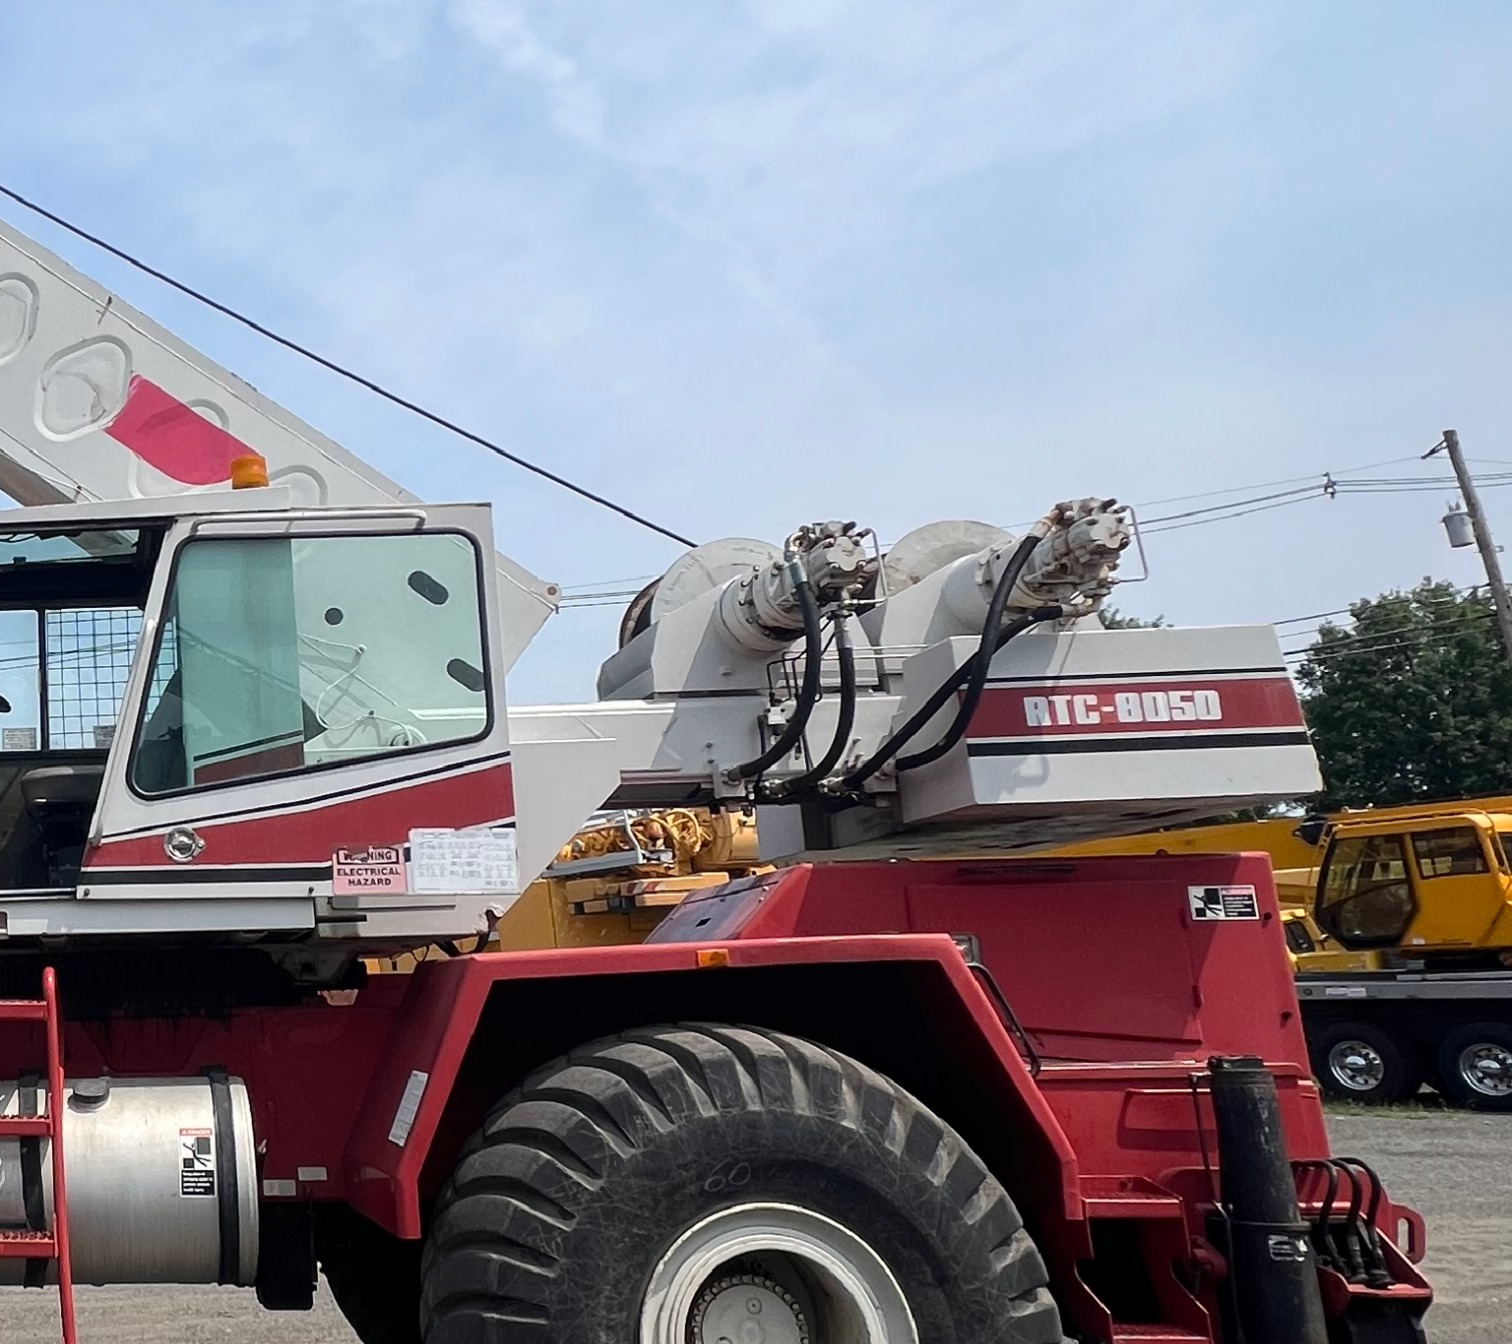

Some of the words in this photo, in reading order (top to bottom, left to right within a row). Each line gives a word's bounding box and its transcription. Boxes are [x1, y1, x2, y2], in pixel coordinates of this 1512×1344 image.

[1023, 690, 1223, 727] RTC-8050
[344, 850, 393, 861] WNING
[337, 867, 401, 877] ELECTRICAL
[348, 878, 392, 887] HAZARD
[704, 1157, 751, 1192] 60
